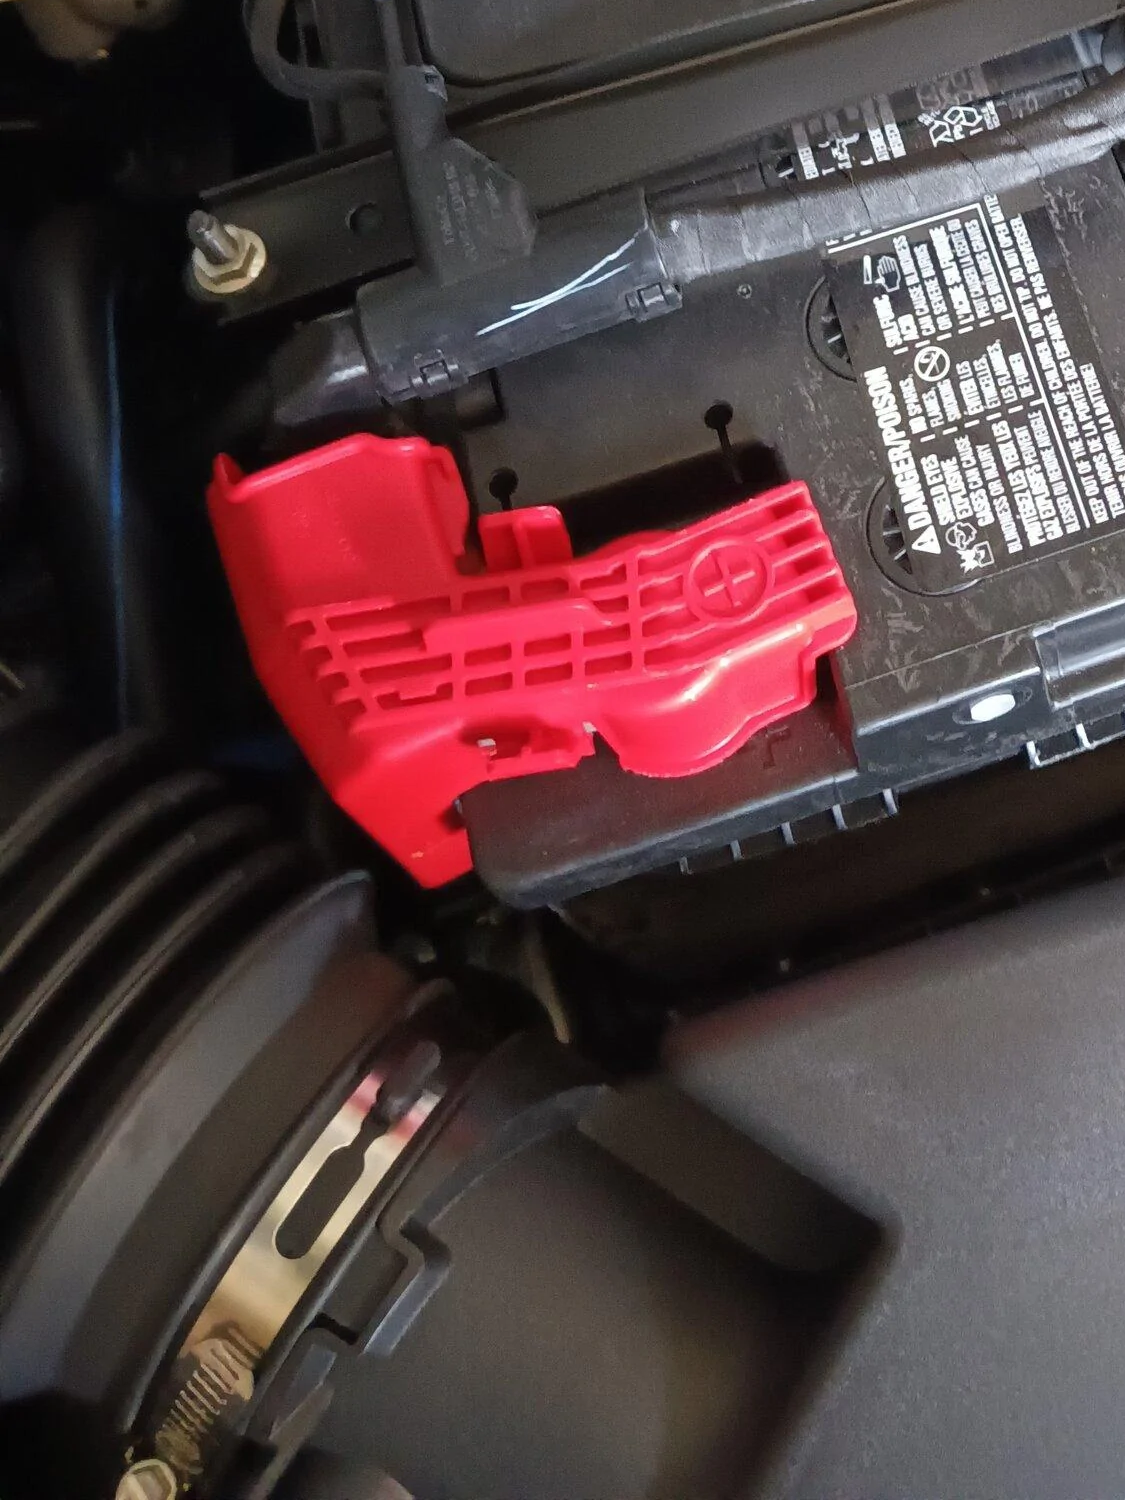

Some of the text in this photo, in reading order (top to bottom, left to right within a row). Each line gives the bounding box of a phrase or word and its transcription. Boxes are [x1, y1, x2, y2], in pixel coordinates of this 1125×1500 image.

[1030, 273, 1047, 294] PAS
[908, 285, 929, 316] CAUSE
[1029, 323, 1044, 338] DO
[956, 361, 972, 379] LES
[1060, 359, 1078, 381] DES
[1052, 391, 1067, 405] OF
[992, 421, 1011, 442] LES
[1057, 404, 1079, 439] REACH
[1082, 421, 1097, 437] LA
[1099, 414, 1114, 430] LA
[864, 366, 932, 530] DANGER/POISON
[1069, 438, 1086, 460] THE
[1087, 436, 1103, 453] DE
[921, 454, 943, 485] EYES
[1075, 460, 1091, 474] OF
[1093, 453, 1114, 484] HORS
[941, 457, 973, 519] EXPLOSIVE
[955, 435, 994, 526] GASES CAN CAUSE
[1008, 470, 1028, 492] LES
[1081, 475, 1099, 496] OUT
[976, 444, 1022, 553] BLINDNESS OR INJURY
[1025, 464, 1056, 520] EXPLOSIFS
[1104, 484, 1125, 518] TENIR
[1057, 494, 1080, 533] BLESSER
[1089, 498, 1109, 523] KEEP
[1043, 517, 1063, 540] GAZ
